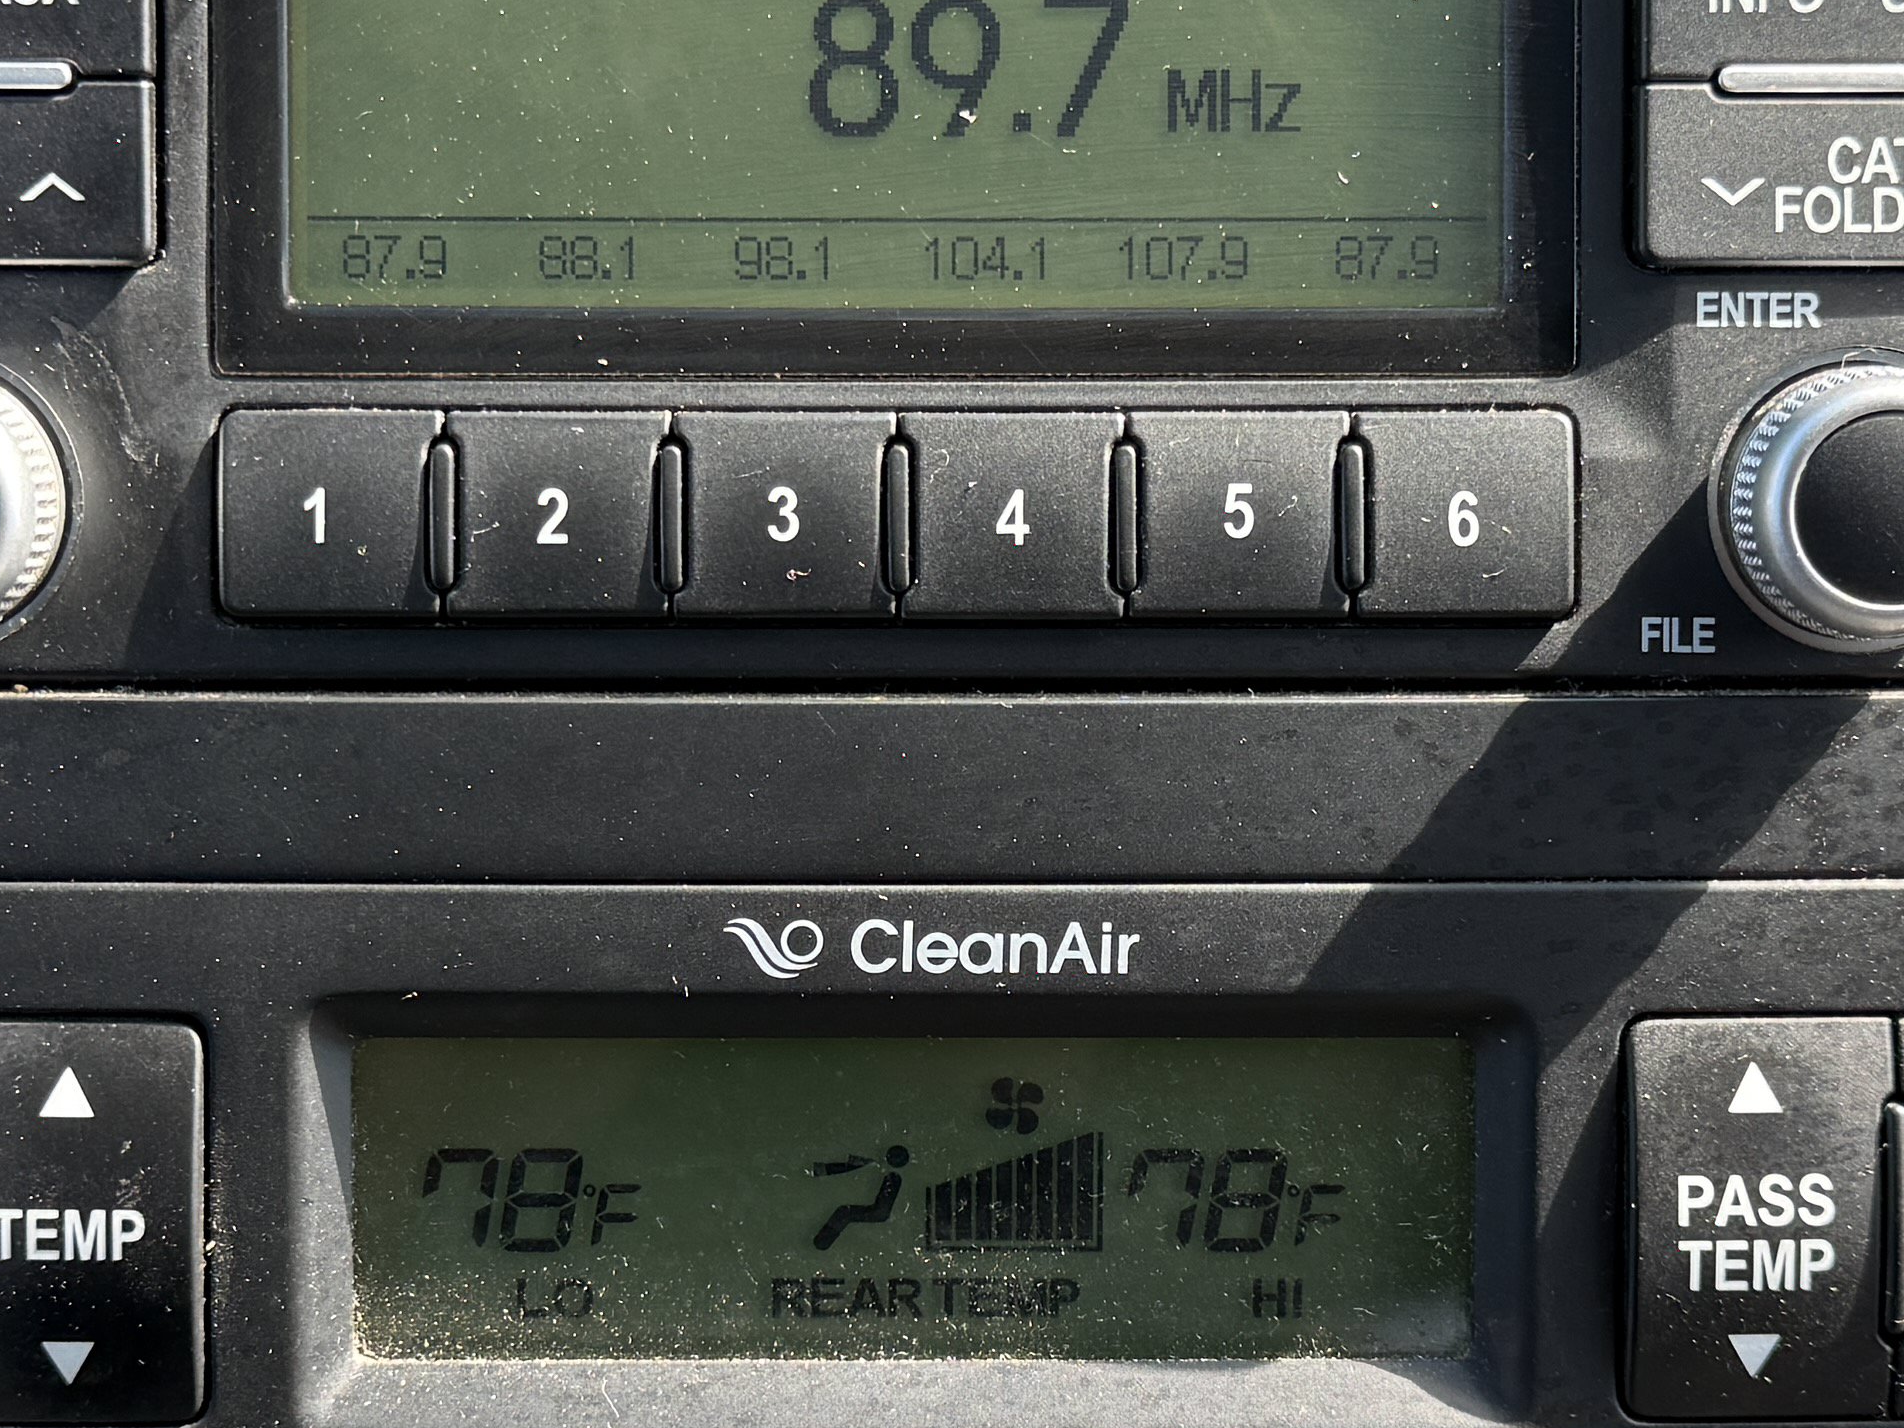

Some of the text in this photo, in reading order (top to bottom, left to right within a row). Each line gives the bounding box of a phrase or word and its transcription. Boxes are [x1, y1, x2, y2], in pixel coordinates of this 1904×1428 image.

[1166, 69, 1301, 133] MHz
[342, 234, 1437, 281] 87.9 88.1 98.1 104.1 107.9 87.9
[1696, 291, 1821, 328] ENTER
[303, 487, 325, 546] 1
[537, 487, 570, 547] 2
[767, 485, 801, 544] 3
[996, 488, 1032, 547] 4
[1223, 482, 1256, 540] 5
[1447, 490, 1480, 548] 6
[1640, 617, 1716, 653] FILE
[850, 918, 1140, 975] CleanAir
[1676, 1173, 1836, 1228] PASS
[1676, 1239, 1835, 1292] TEMP
[515, 1277, 595, 1319] LO
[771, 1277, 1081, 1319] REAR TEMP
[1251, 1278, 1304, 1318] HI
